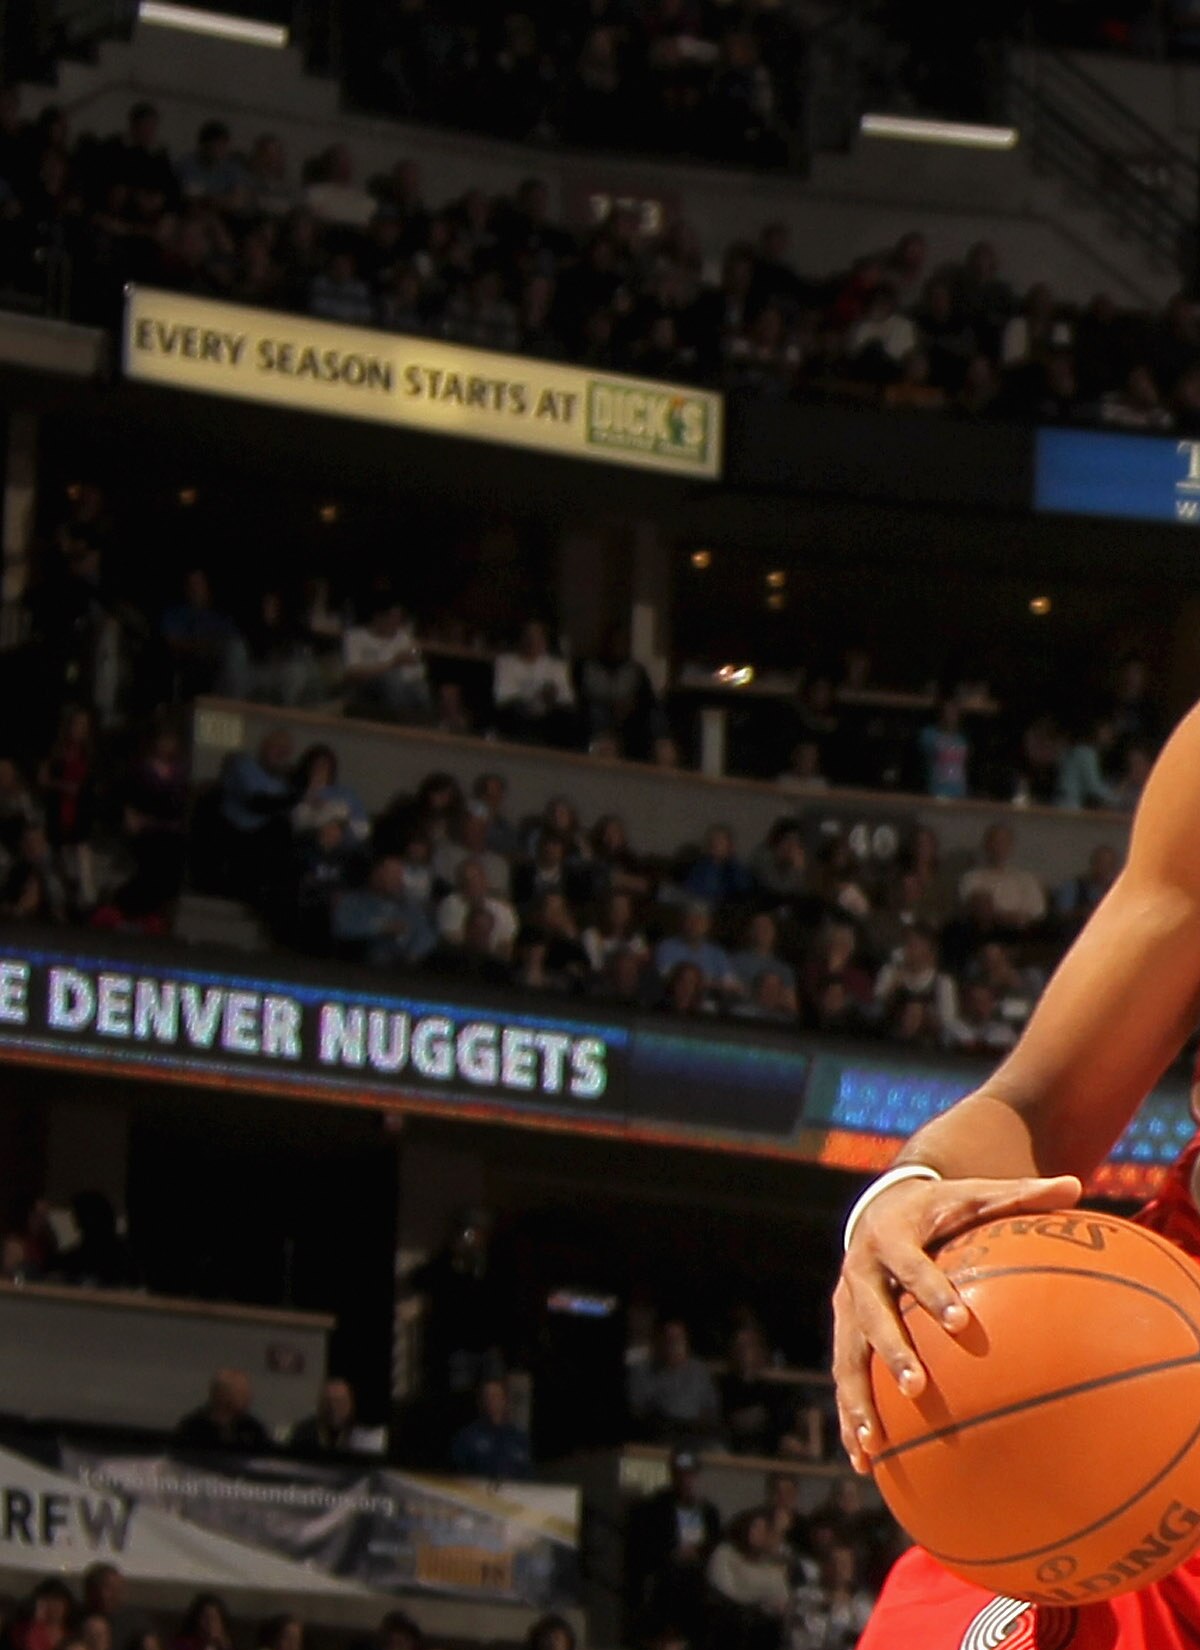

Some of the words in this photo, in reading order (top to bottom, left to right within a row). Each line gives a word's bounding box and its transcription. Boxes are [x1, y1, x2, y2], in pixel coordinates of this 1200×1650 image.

[135, 318, 246, 365] EVERY
[257, 338, 392, 393] SEASON
[403, 364, 526, 416] STARTS
[533, 388, 578, 423] AT
[47, 966, 303, 1060] DENVER
[318, 1001, 608, 1101] NUGGETS
